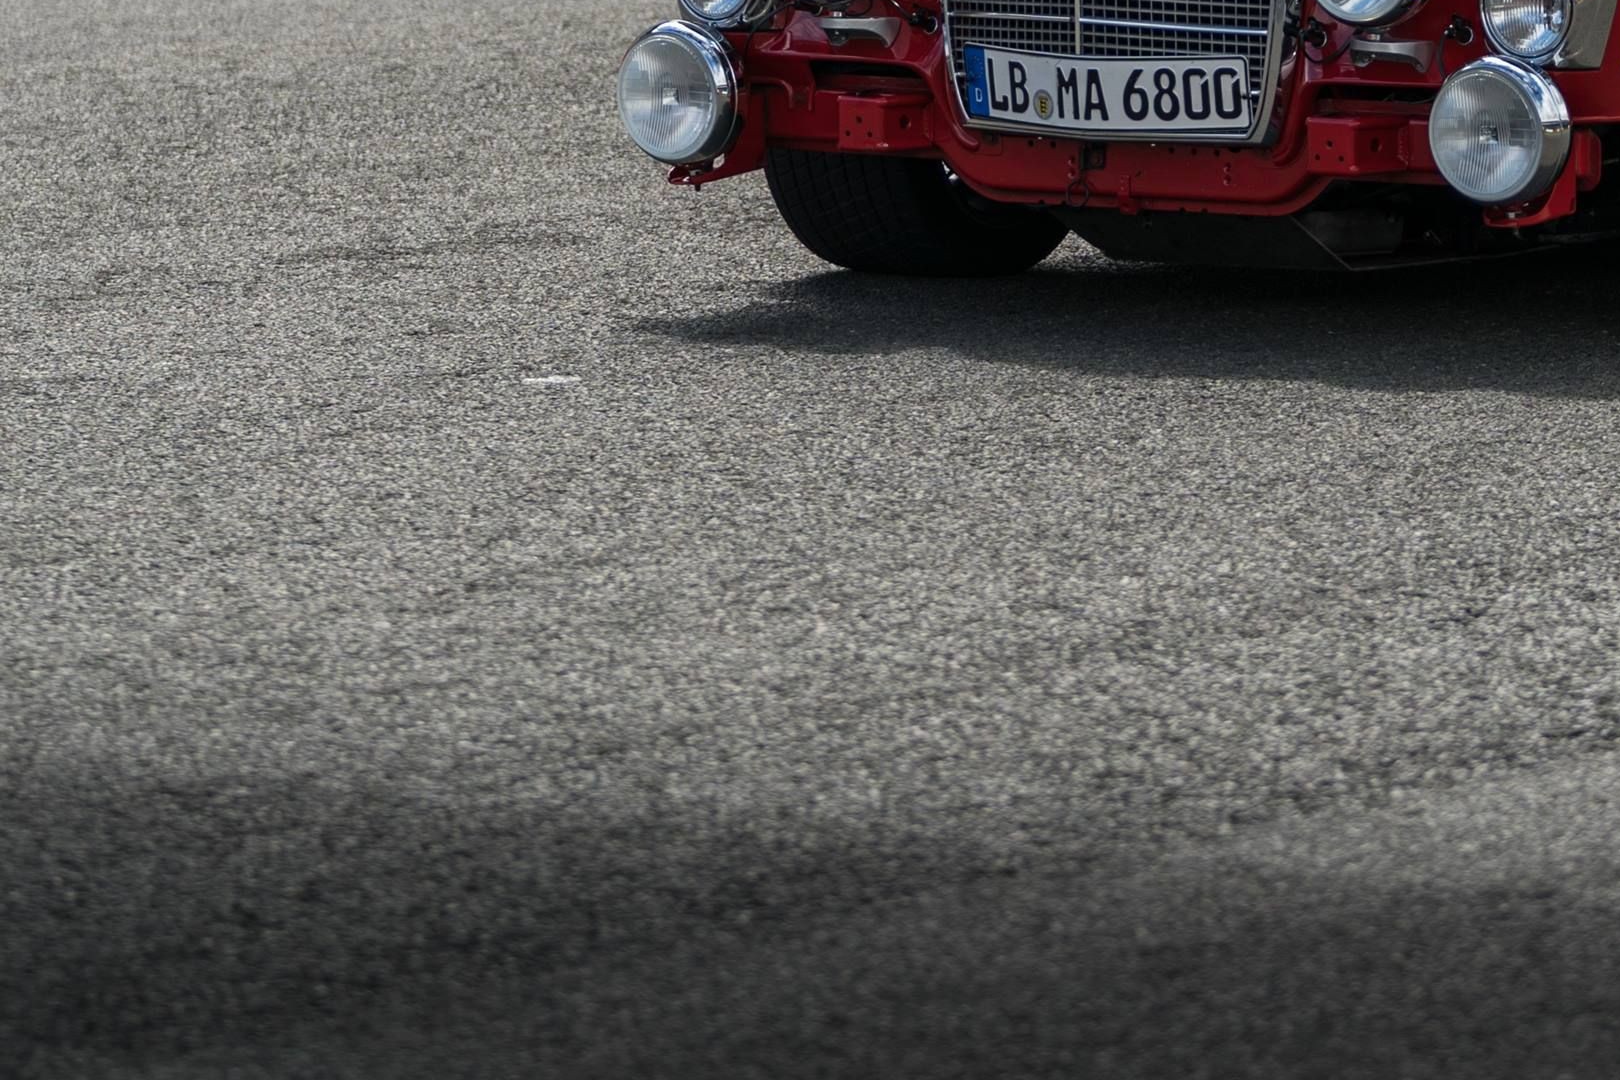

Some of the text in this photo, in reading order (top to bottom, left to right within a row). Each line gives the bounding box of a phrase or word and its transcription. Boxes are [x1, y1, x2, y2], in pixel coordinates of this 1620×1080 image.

[987, 58, 1243, 122] LB MA 6800
